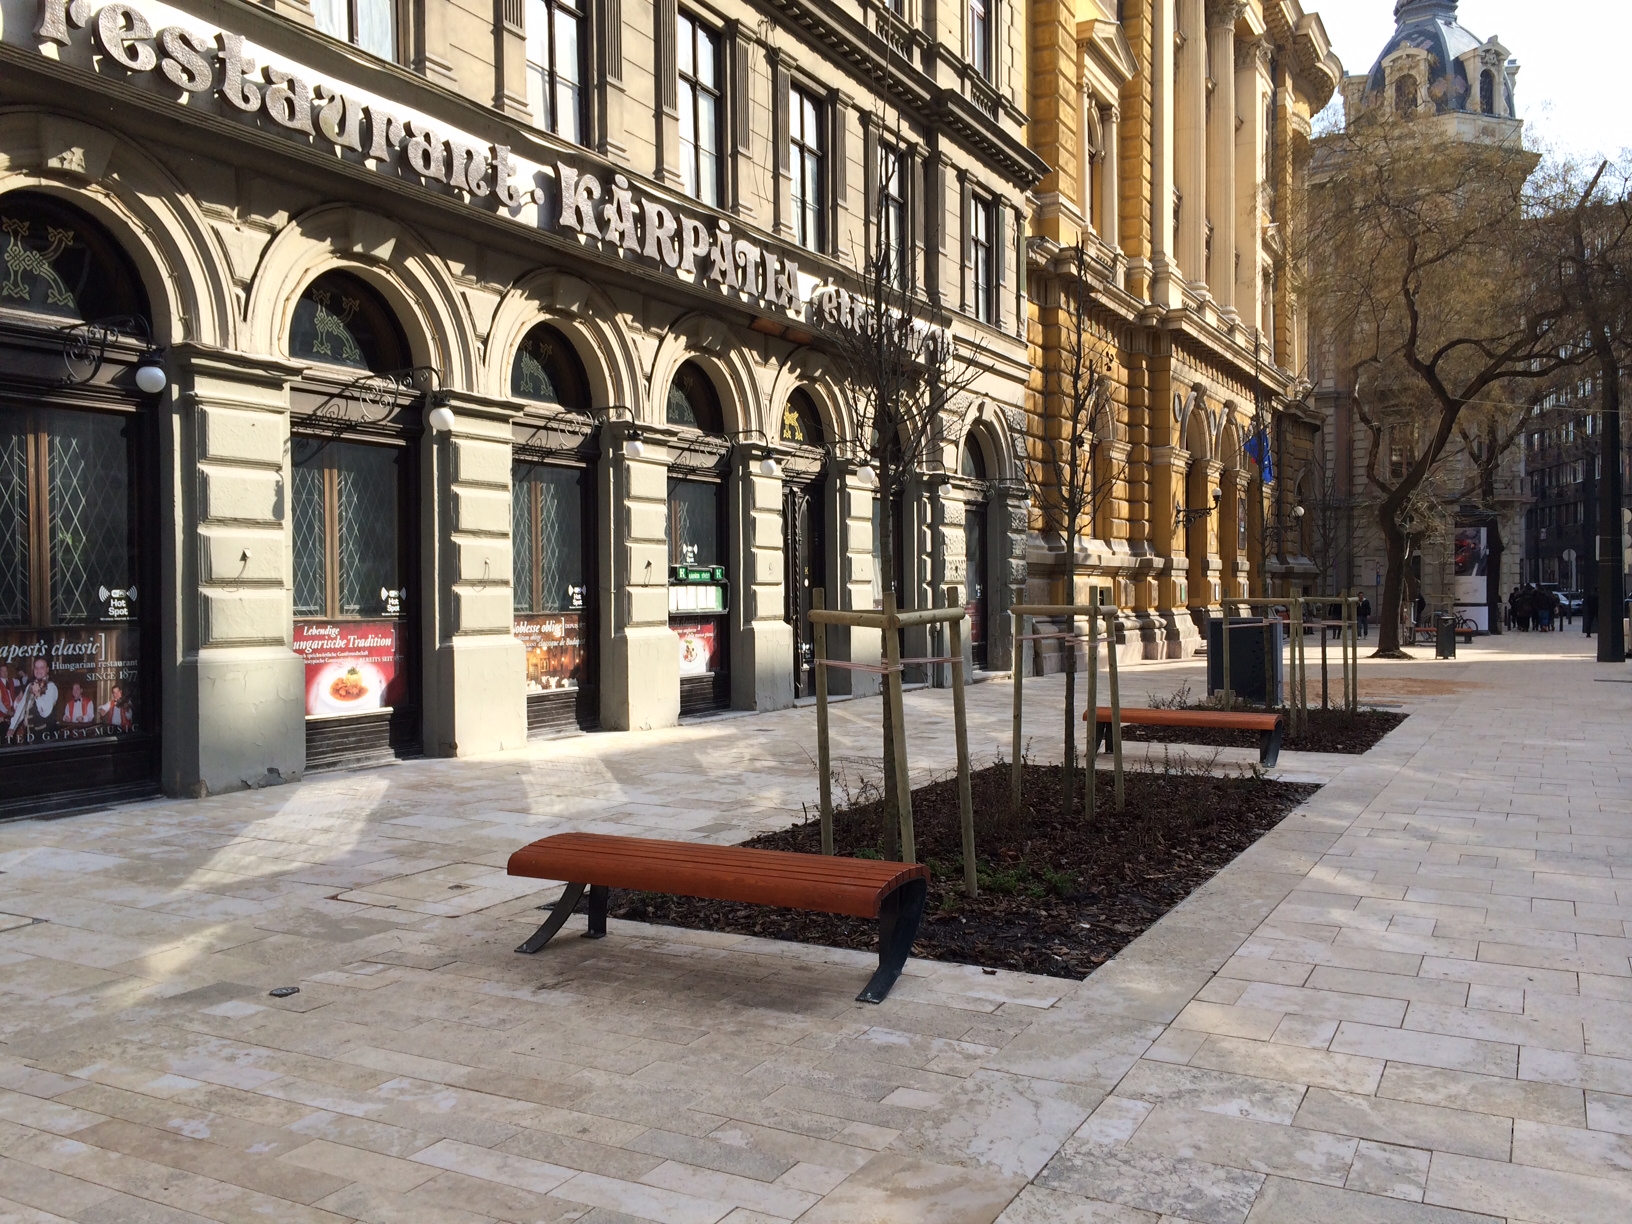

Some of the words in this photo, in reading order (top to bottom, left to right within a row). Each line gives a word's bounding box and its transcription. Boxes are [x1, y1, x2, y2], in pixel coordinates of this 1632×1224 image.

[110, 598, 127, 607] Hot
[108, 607, 129, 618] Spot
[303, 625, 340, 637] Lebendige
[51, 661, 96, 671] Hungarian
[98, 659, 138, 668] restaurant
[86, 671, 116, 681] SINCE
[119, 667, 138, 682] 1877
[41, 727, 88, 741] GYPSY
[94, 723, 140, 736] MUSIC
